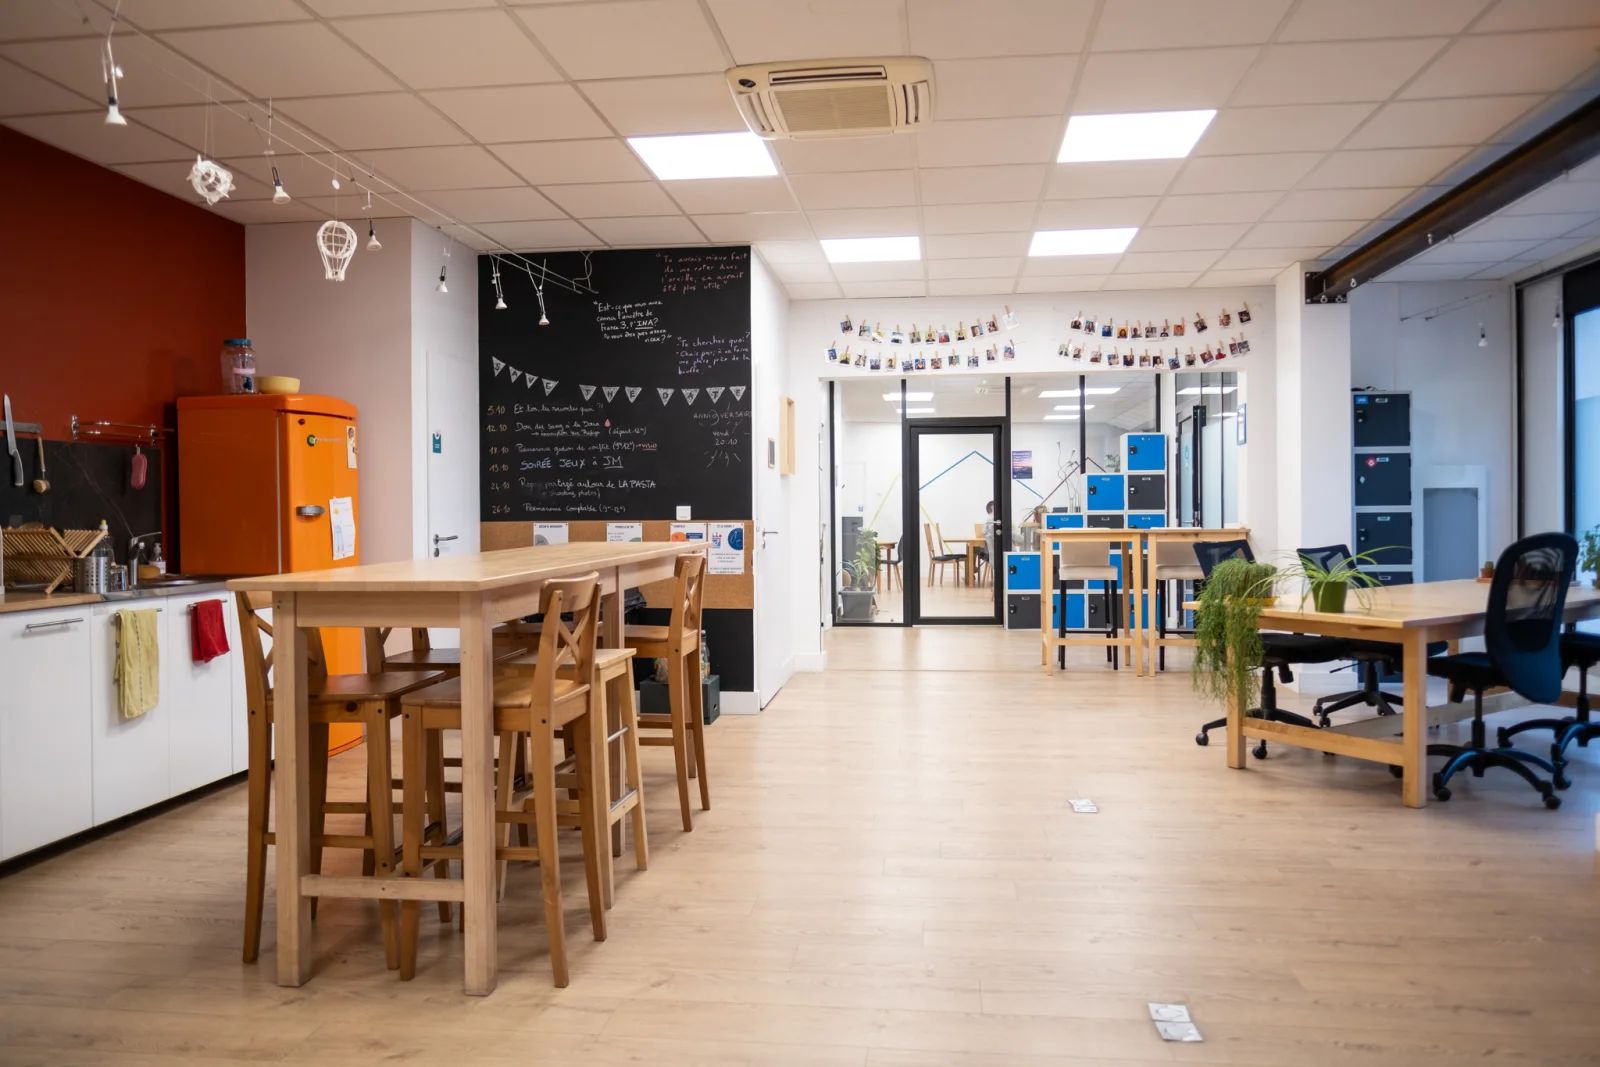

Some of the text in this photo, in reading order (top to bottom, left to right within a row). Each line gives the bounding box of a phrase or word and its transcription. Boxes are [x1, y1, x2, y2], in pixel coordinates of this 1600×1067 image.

[731, 251, 748, 261] fait
[682, 284, 697, 295] plus
[693, 335, 725, 347] cherches
[494, 360, 555, 391] SAVE
[583, 385, 744, 402] THE DATE
[513, 403, 525, 415] Et
[515, 422, 533, 432] Don
[534, 422, 545, 430] du
[576, 443, 585, 451] de
[715, 438, 738, 446] 20.10
[559, 458, 586, 469] JEUX
[602, 455, 623, 468] JM
[605, 479, 616, 489] de
[618, 479, 628, 489] LA
[629, 479, 657, 489] PASTA
